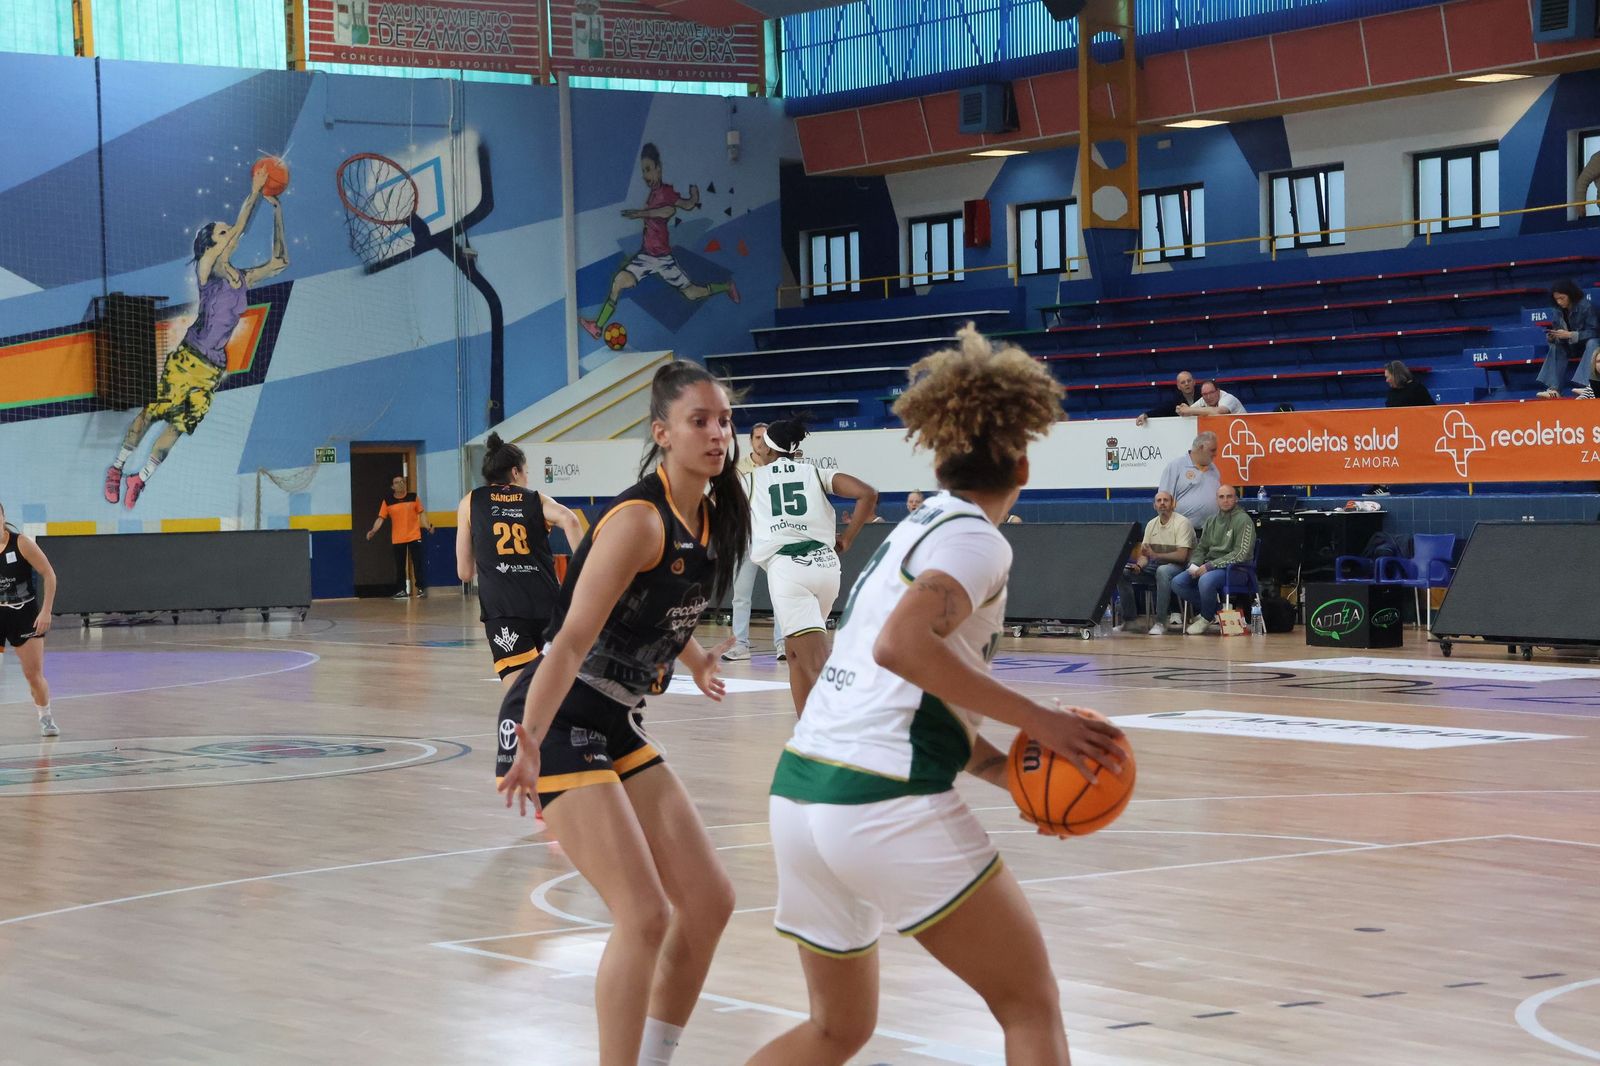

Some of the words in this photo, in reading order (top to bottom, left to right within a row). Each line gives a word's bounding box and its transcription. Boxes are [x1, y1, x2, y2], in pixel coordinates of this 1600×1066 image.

[378, 4, 512, 30] AYUNTAMIENTO
[377, 22, 406, 47] DE
[412, 25, 515, 54] ZAMORA
[612, 36, 641, 58] DE
[646, 39, 736, 62] ZAMORA
[450, 60, 510, 70] DEPORTES
[678, 69, 733, 79] DEPORTES
[1269, 429, 1349, 454] recoletas
[1354, 426, 1399, 451] salud
[1490, 419, 1585, 447] recoletas
[1120, 445, 1163, 461] ZAMORA
[1344, 456, 1400, 469] ZAMORA
[772, 465, 782, 474] B.
[768, 481, 808, 517] 15
[492, 521, 531, 556] 28
[1230, 717, 1532, 741] MOLENDUM
